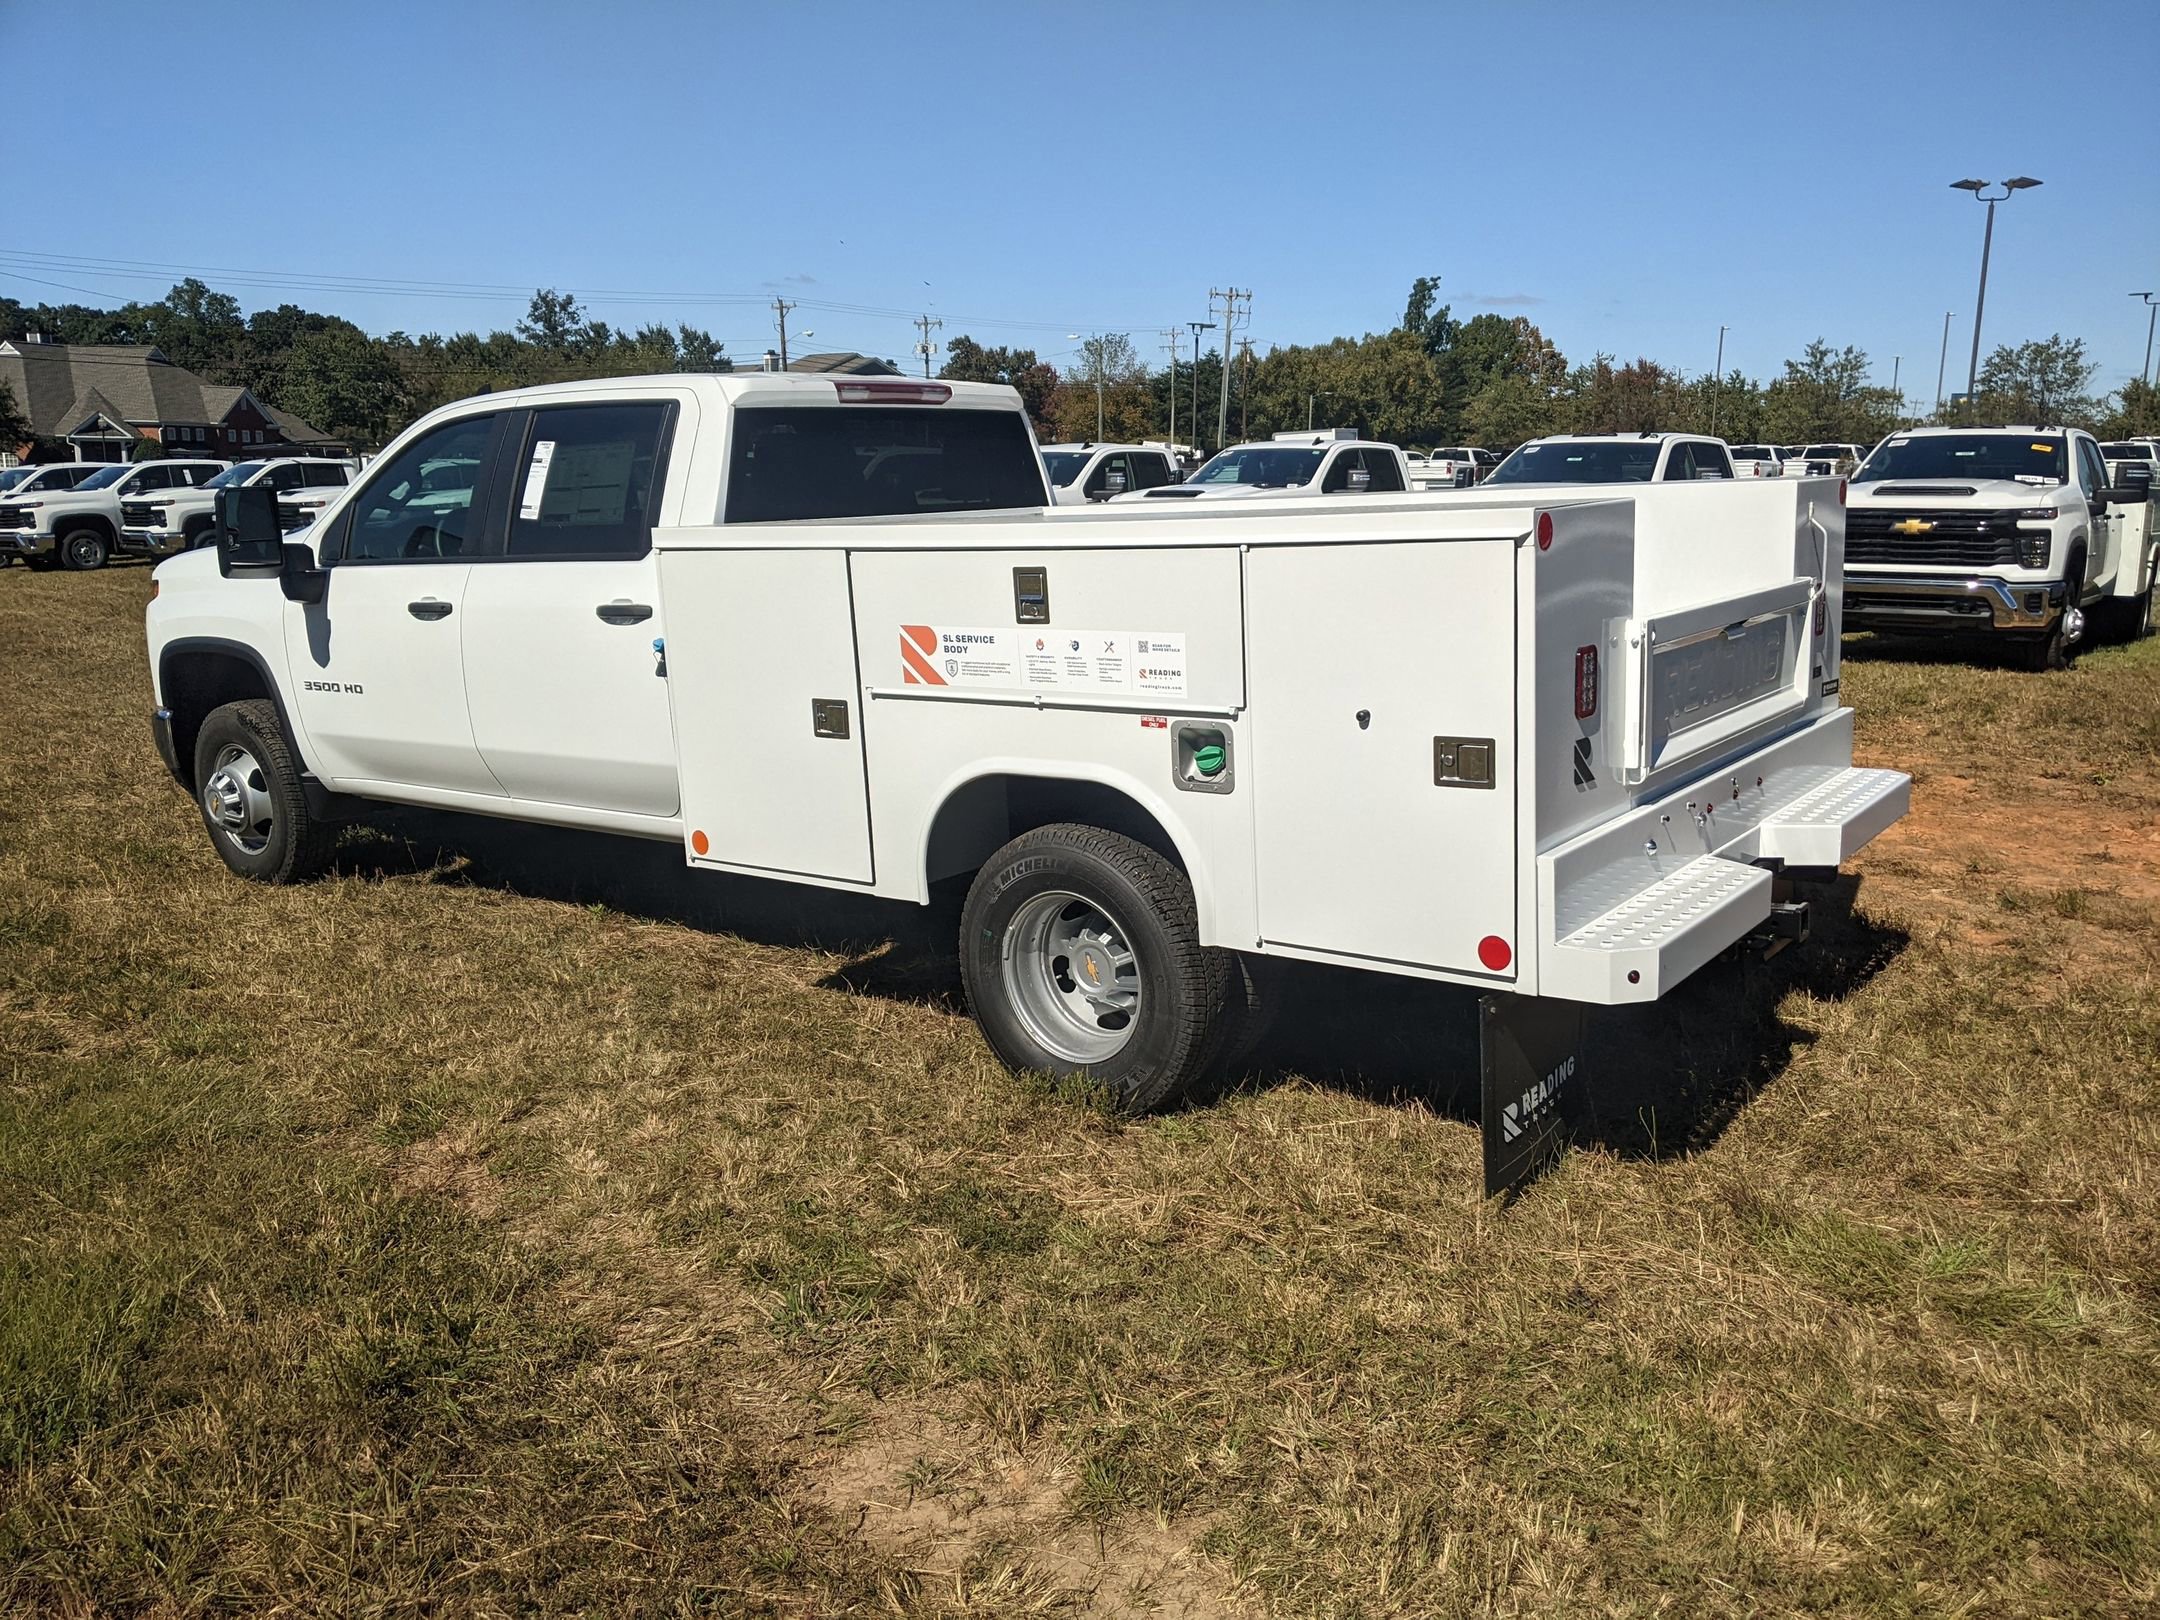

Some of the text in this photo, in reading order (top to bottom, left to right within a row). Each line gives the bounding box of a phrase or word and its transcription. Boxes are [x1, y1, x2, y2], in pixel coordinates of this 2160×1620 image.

[942, 634, 995, 644] SL SERVICE
[944, 645, 968, 654] BODY
[1148, 669, 1181, 677] READING
[304, 681, 364, 695] 3500 HD
[1000, 858, 1067, 884] MICHELIN
[1522, 1055, 1575, 1116] READING
